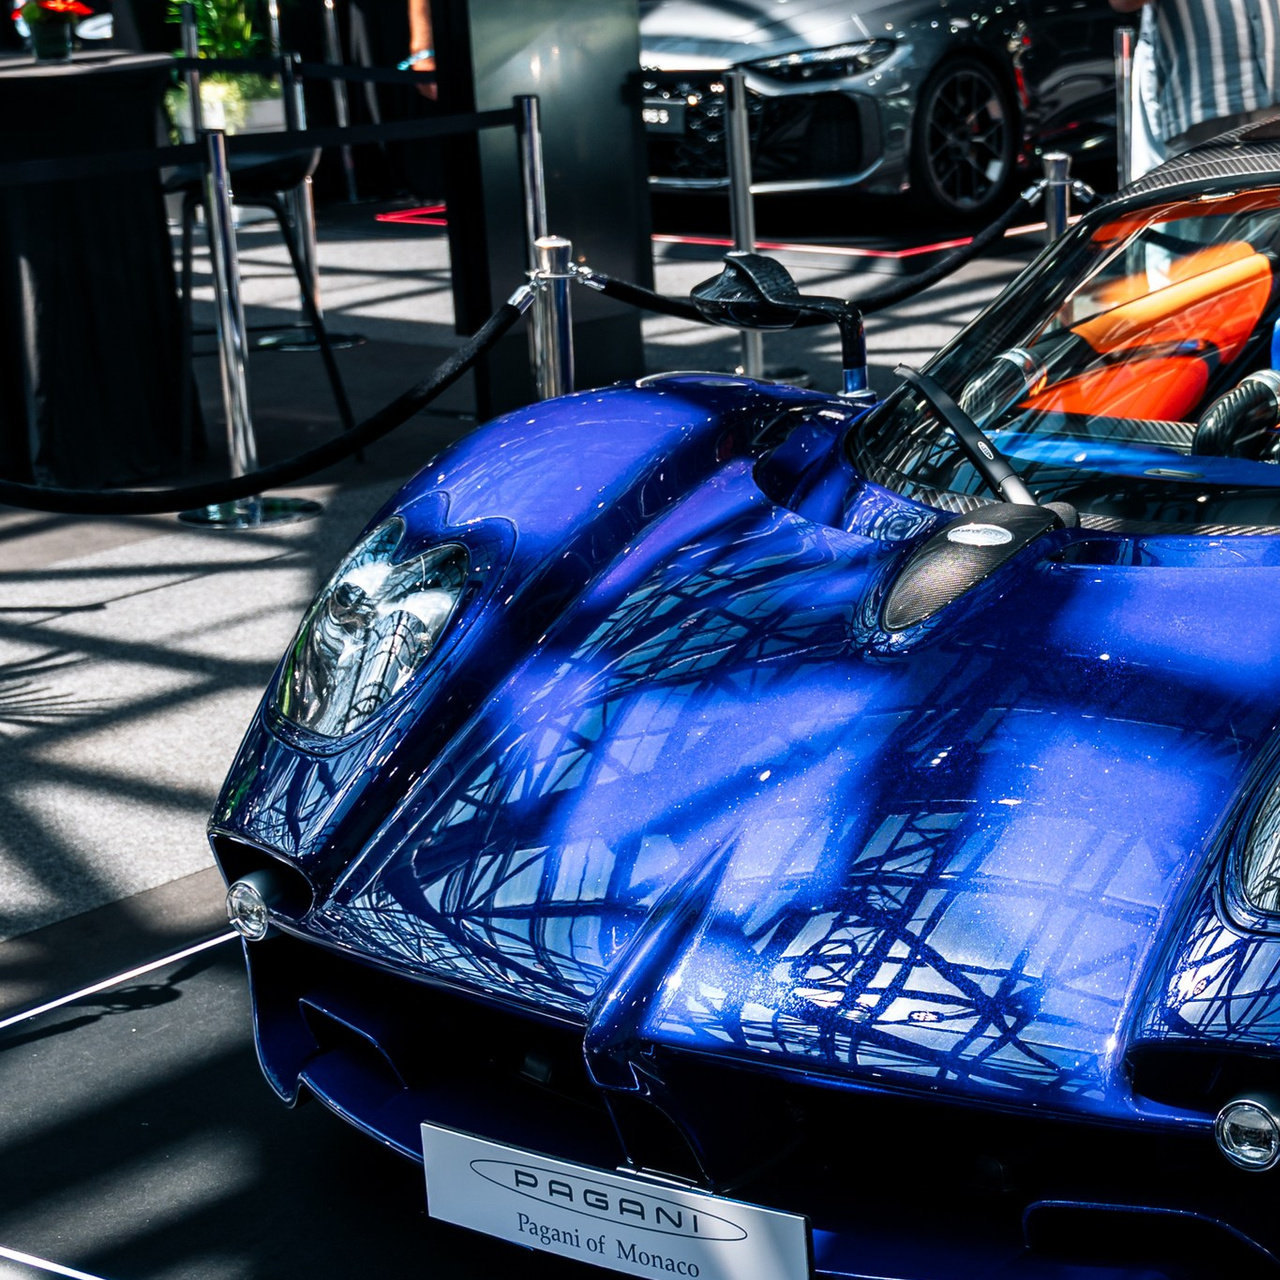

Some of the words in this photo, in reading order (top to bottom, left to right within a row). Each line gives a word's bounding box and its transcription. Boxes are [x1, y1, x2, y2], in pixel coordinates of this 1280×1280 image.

[514, 1169, 699, 1234] PAGANI
[517, 1212, 580, 1248] Pagani
[586, 1235, 606, 1255] of
[616, 1239, 700, 1278] Monaco
